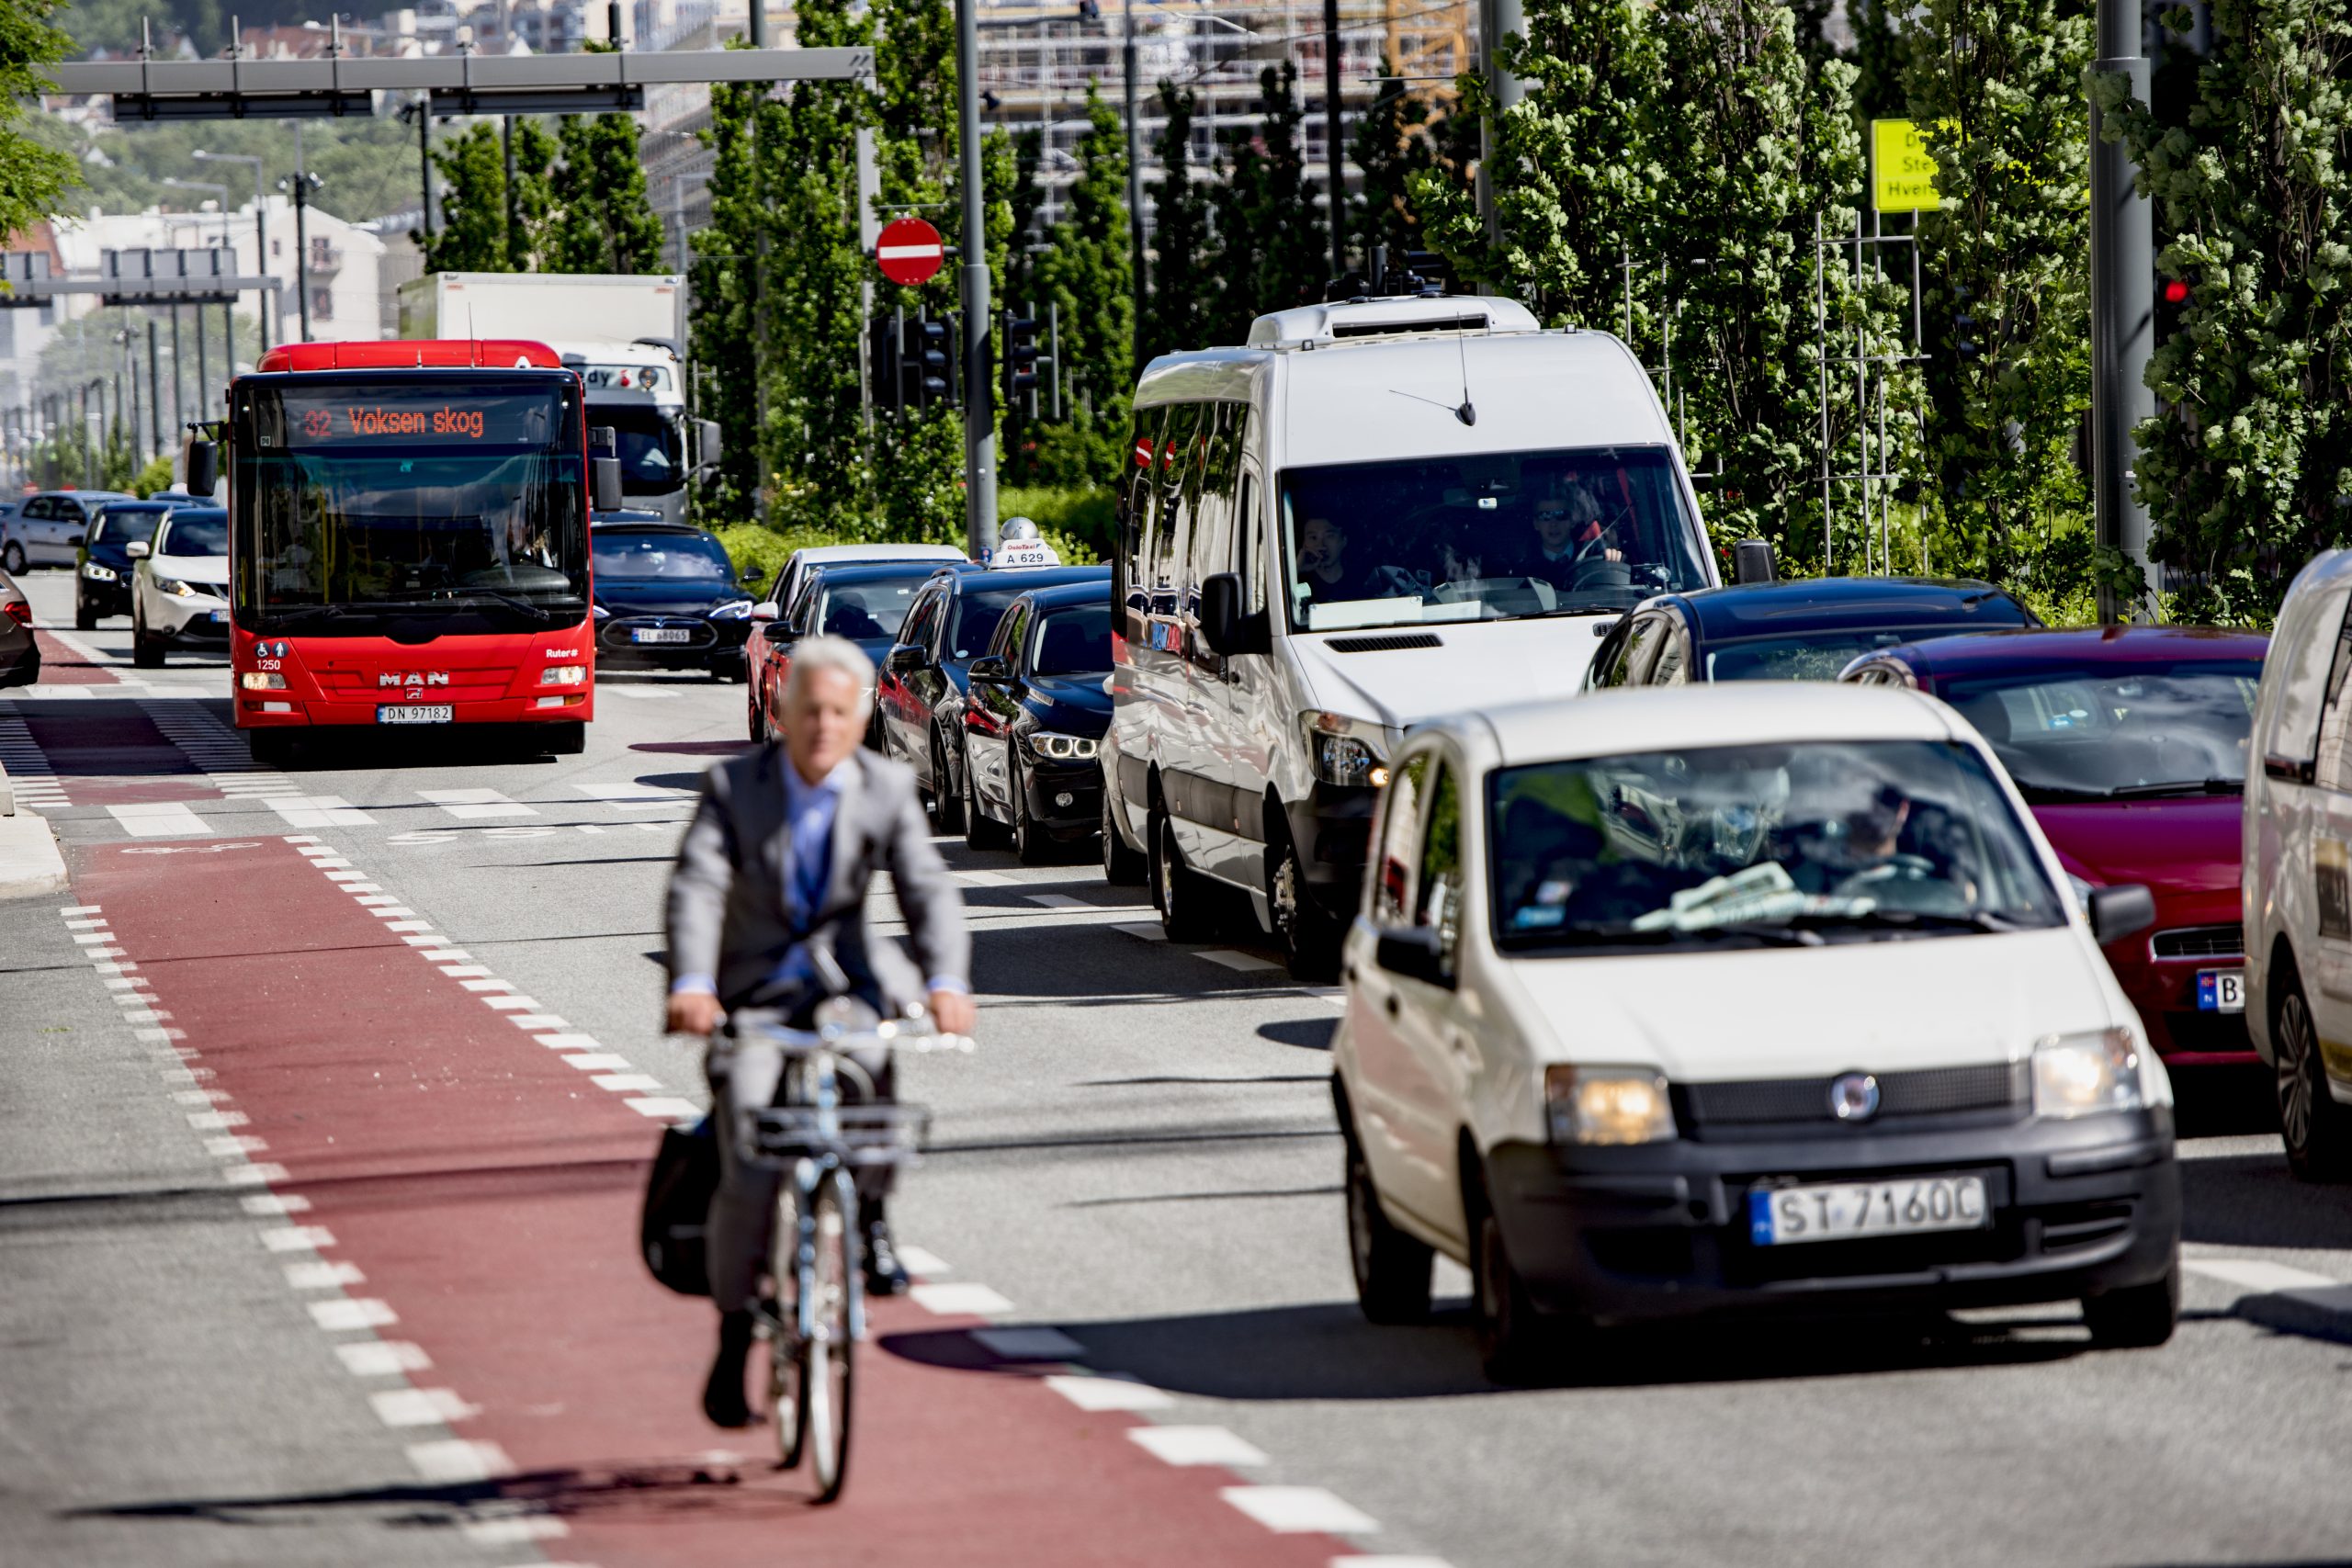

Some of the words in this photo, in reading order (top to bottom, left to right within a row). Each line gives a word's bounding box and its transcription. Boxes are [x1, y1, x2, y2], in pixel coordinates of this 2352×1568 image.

[304, 410, 332, 436] 32
[348, 406, 425, 434] Voksen
[433, 406, 483, 438] skog
[1007, 554, 1015, 564] A
[1021, 553, 1044, 563] 629
[256, 660, 281, 671] 1250
[379, 671, 449, 686] MAN
[388, 707, 406, 720] DN
[411, 706, 448, 720] 97182
[2222, 976, 2238, 1004] B
[1780, 1190, 1832, 1235] ST
[1853, 1175, 1982, 1228] 7160C
